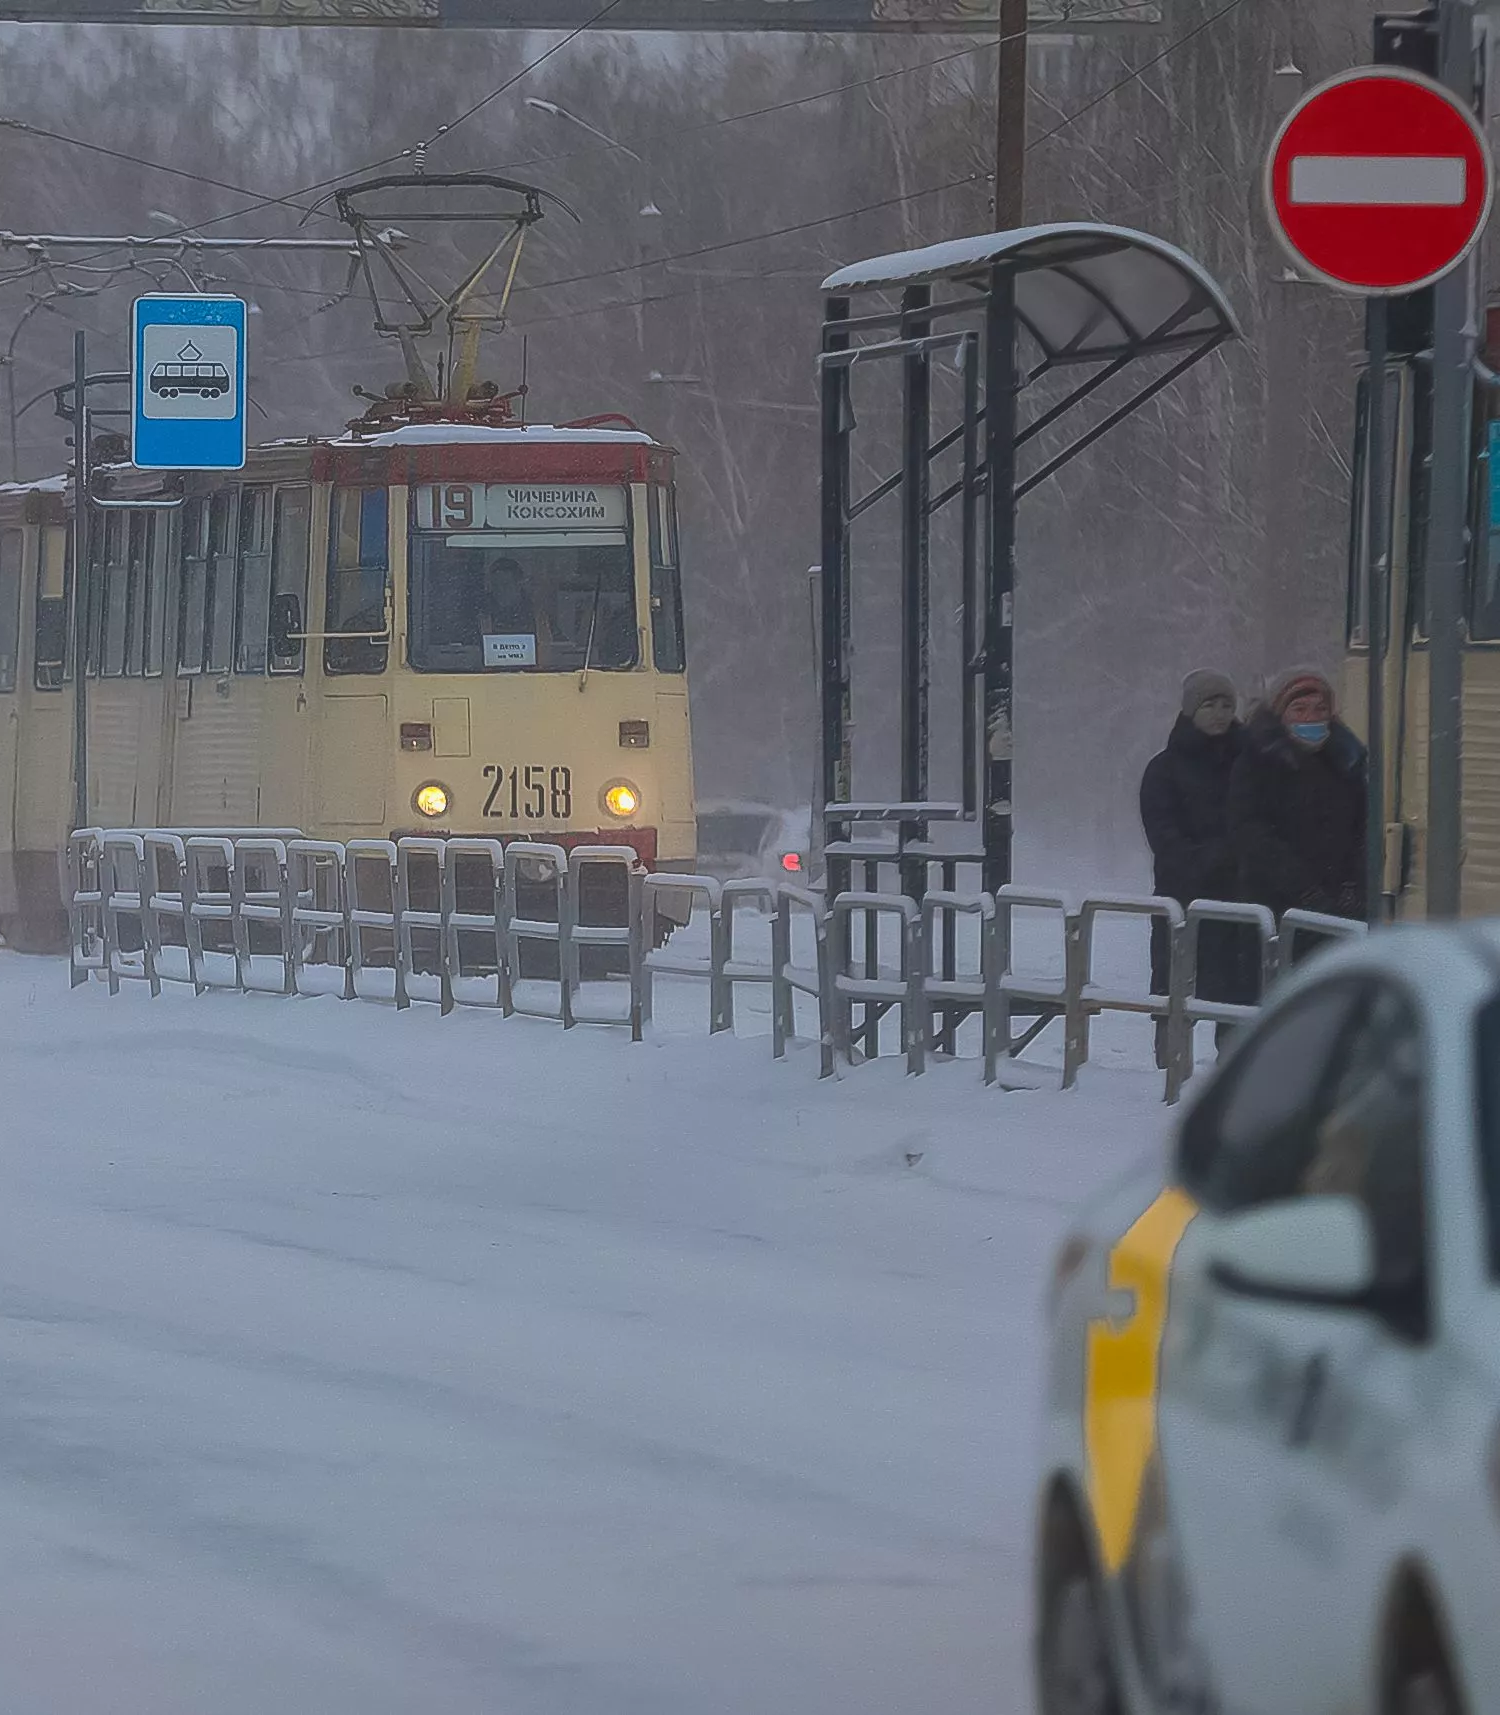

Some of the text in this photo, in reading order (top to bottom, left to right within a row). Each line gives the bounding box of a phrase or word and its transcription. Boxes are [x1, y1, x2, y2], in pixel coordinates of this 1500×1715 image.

[432, 484, 474, 528] 19
[507, 489, 598, 503] ЧИЧЕРИНА
[507, 505, 606, 519] КОКСОХИМ
[482, 765, 572, 819] 2158
